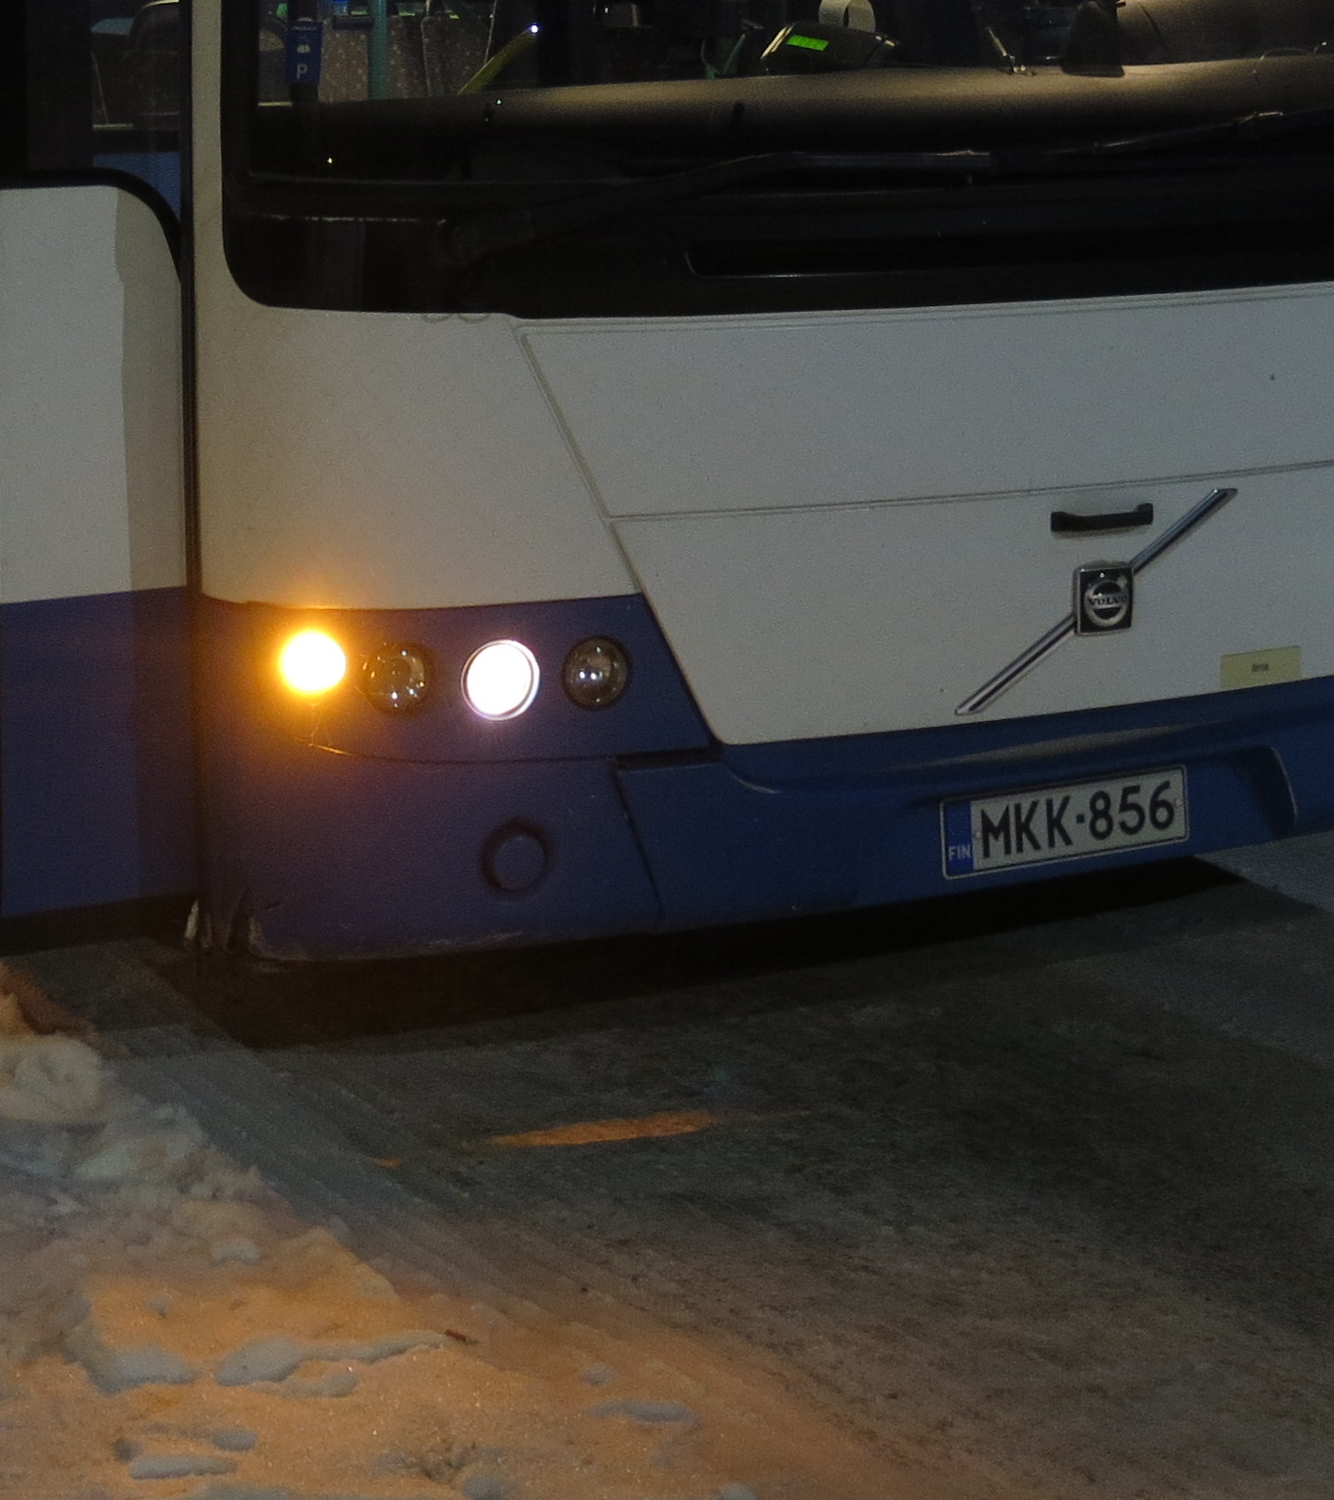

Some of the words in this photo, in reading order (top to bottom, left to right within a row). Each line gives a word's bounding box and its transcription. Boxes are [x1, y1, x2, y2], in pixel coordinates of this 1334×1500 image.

[1087, 593, 1128, 606] VOLVO
[948, 844, 972, 861] FIN
[980, 780, 1175, 859] MKK-856
